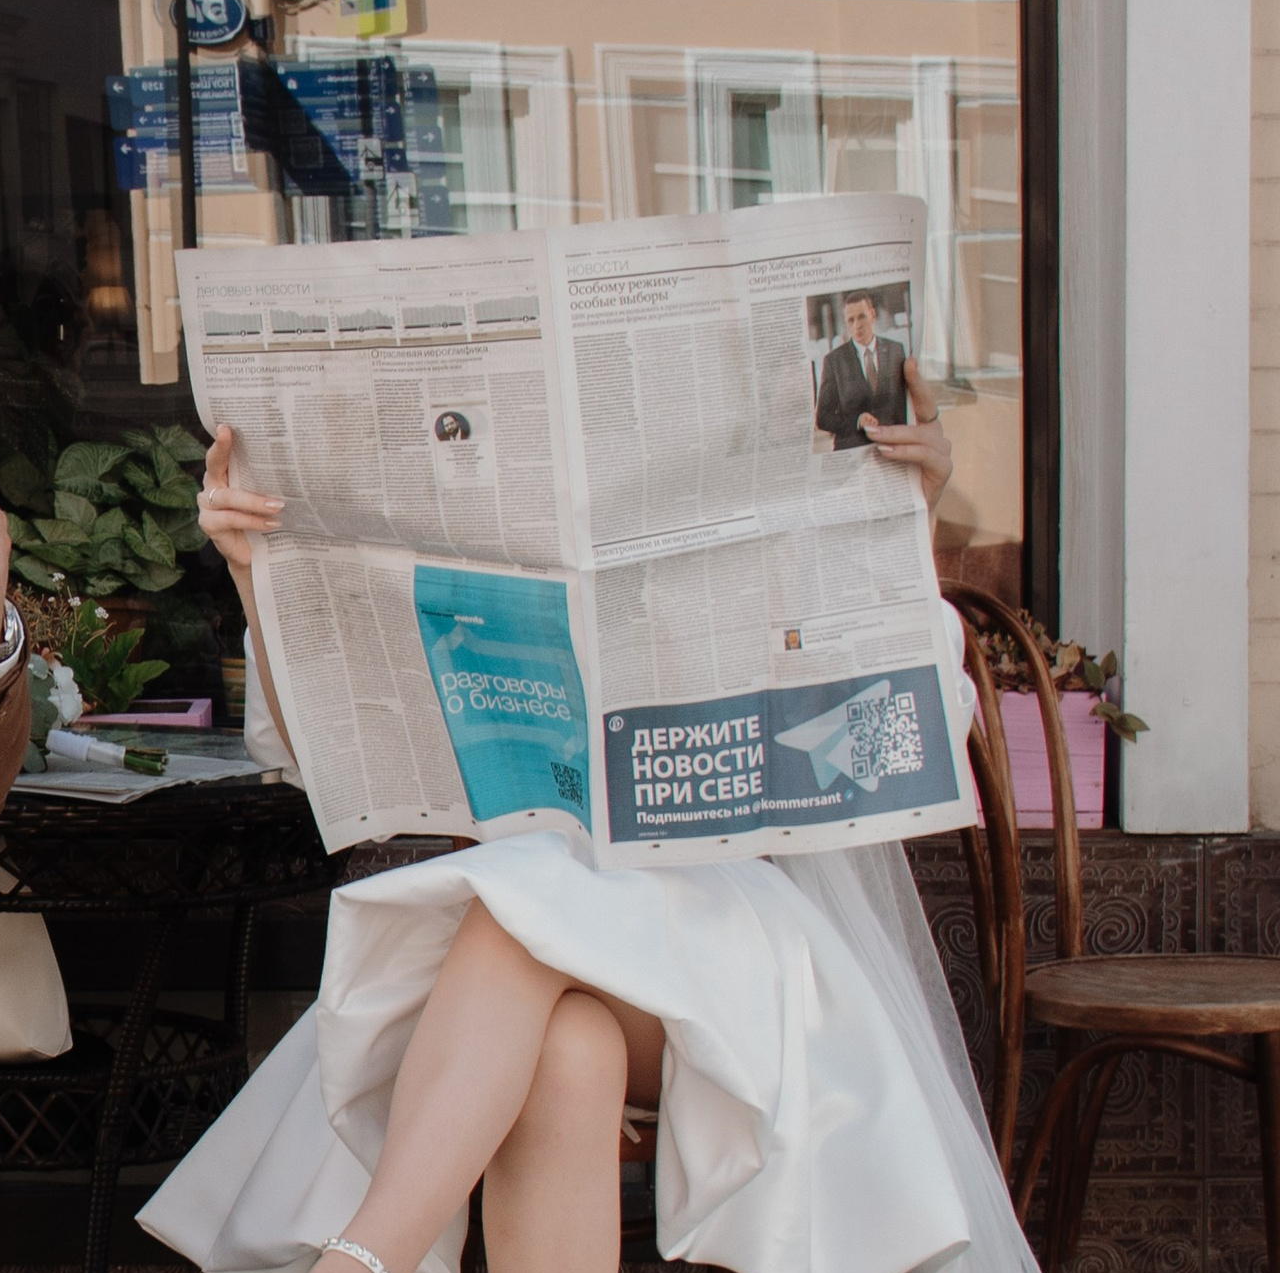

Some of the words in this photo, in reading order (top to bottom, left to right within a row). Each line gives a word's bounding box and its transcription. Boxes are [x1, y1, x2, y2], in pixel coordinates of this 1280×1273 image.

[196, 284, 253, 299] деловые
[568, 281, 626, 296] Особому
[628, 274, 679, 293] режиму
[570, 294, 617, 310] особые
[619, 290, 669, 306] выборы
[440, 671, 568, 702] разговоры
[446, 694, 464, 715] о
[469, 686, 572, 722] бизнесе
[630, 714, 763, 758] ДЕРЖИТЕ
[632, 741, 766, 781] НОВОСТИ
[634, 780, 694, 807] ПРИ
[698, 770, 764, 803] СЕБЕ
[636, 805, 732, 826] Подпишитесь
[734, 805, 751, 817] на
[751, 790, 843, 814] @kommersant
